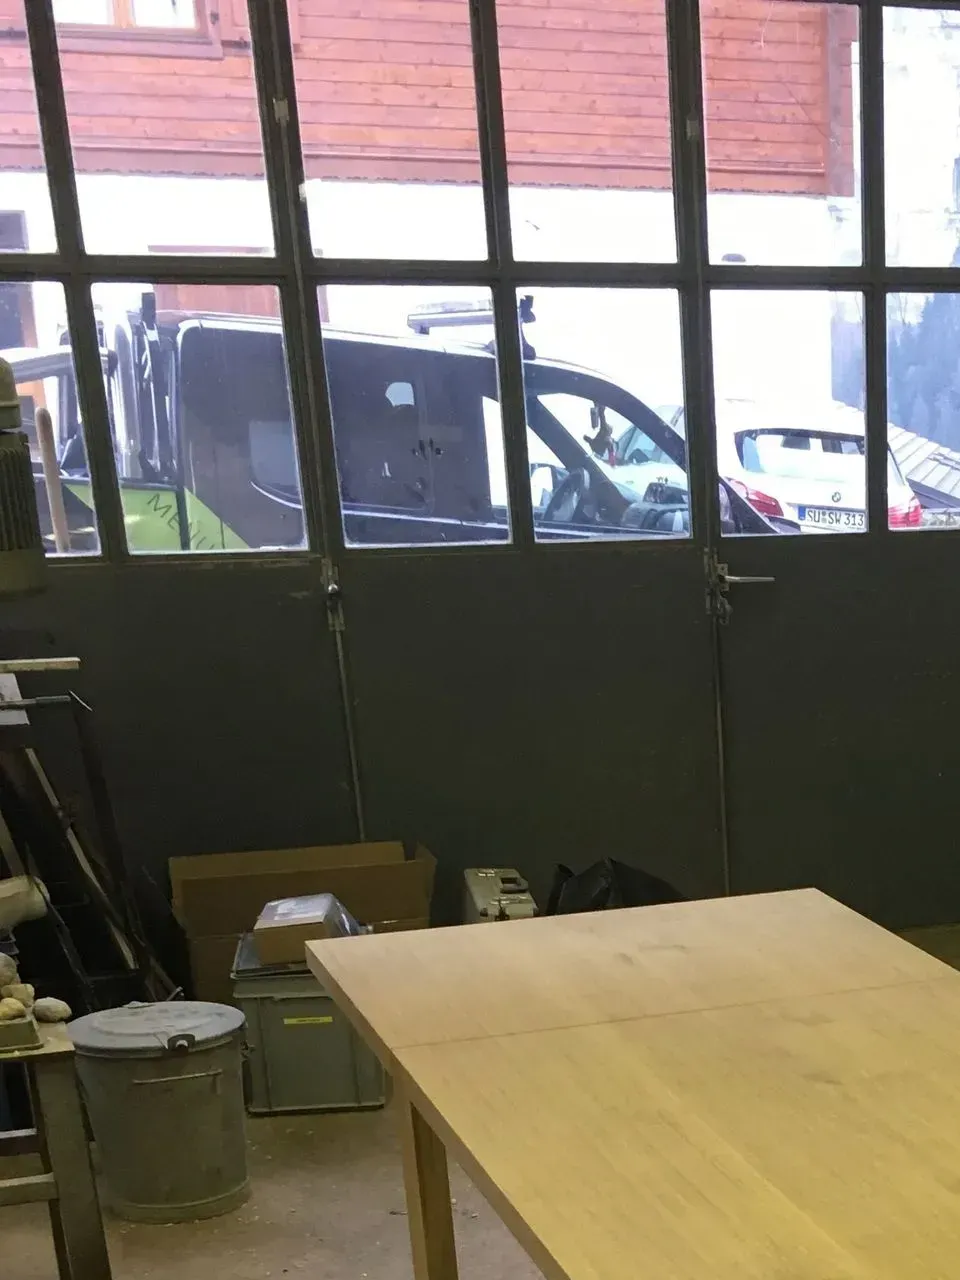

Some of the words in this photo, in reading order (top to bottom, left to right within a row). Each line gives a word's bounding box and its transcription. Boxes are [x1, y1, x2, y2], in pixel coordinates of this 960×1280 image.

[807, 510, 820, 523] SU
[828, 511, 842, 525] SW
[844, 513, 864, 526] 313
